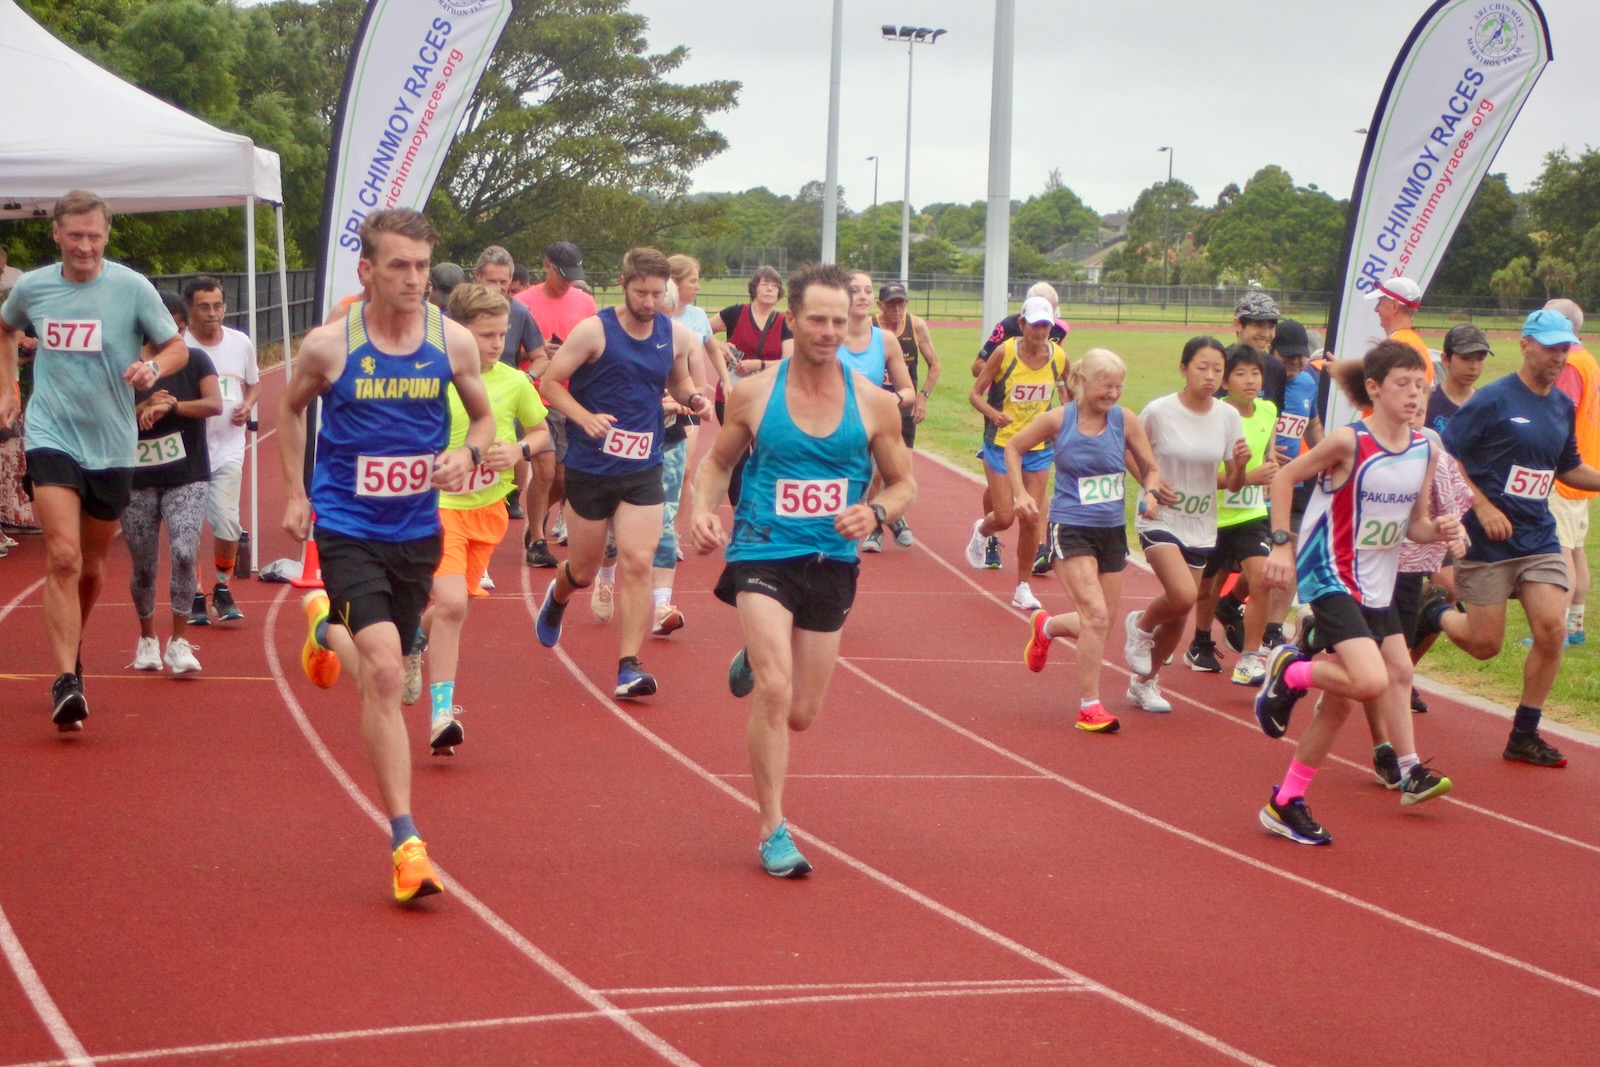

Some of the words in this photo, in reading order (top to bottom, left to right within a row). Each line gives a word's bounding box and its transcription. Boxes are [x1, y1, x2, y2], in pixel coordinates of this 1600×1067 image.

[1474, 7, 1487, 19] SRI
[1489, 3, 1524, 28] CHINMOY
[1467, 37, 1500, 67] MARATHON
[359, 96, 415, 207] CHINMOY
[404, 17, 452, 98] RACES
[1356, 253, 1388, 294] SRI
[1377, 144, 1441, 253] CHINMOY
[1430, 67, 1484, 147] RACES
[1390, 98, 1494, 279] z.srichinmoyraces.org
[47, 322, 97, 348] 577
[355, 377, 440, 399] TAKAPUNA
[1014, 384, 1046, 400] 571
[1276, 415, 1306, 437] 576
[137, 436, 180, 463] 213
[608, 431, 650, 457] 579
[363, 459, 428, 493] 569
[454, 461, 495, 493] 75
[1082, 475, 1119, 501] 201
[1511, 469, 1550, 496] 578
[781, 483, 842, 514] 563
[1167, 490, 1211, 514] 206
[1226, 485, 1261, 505] 207
